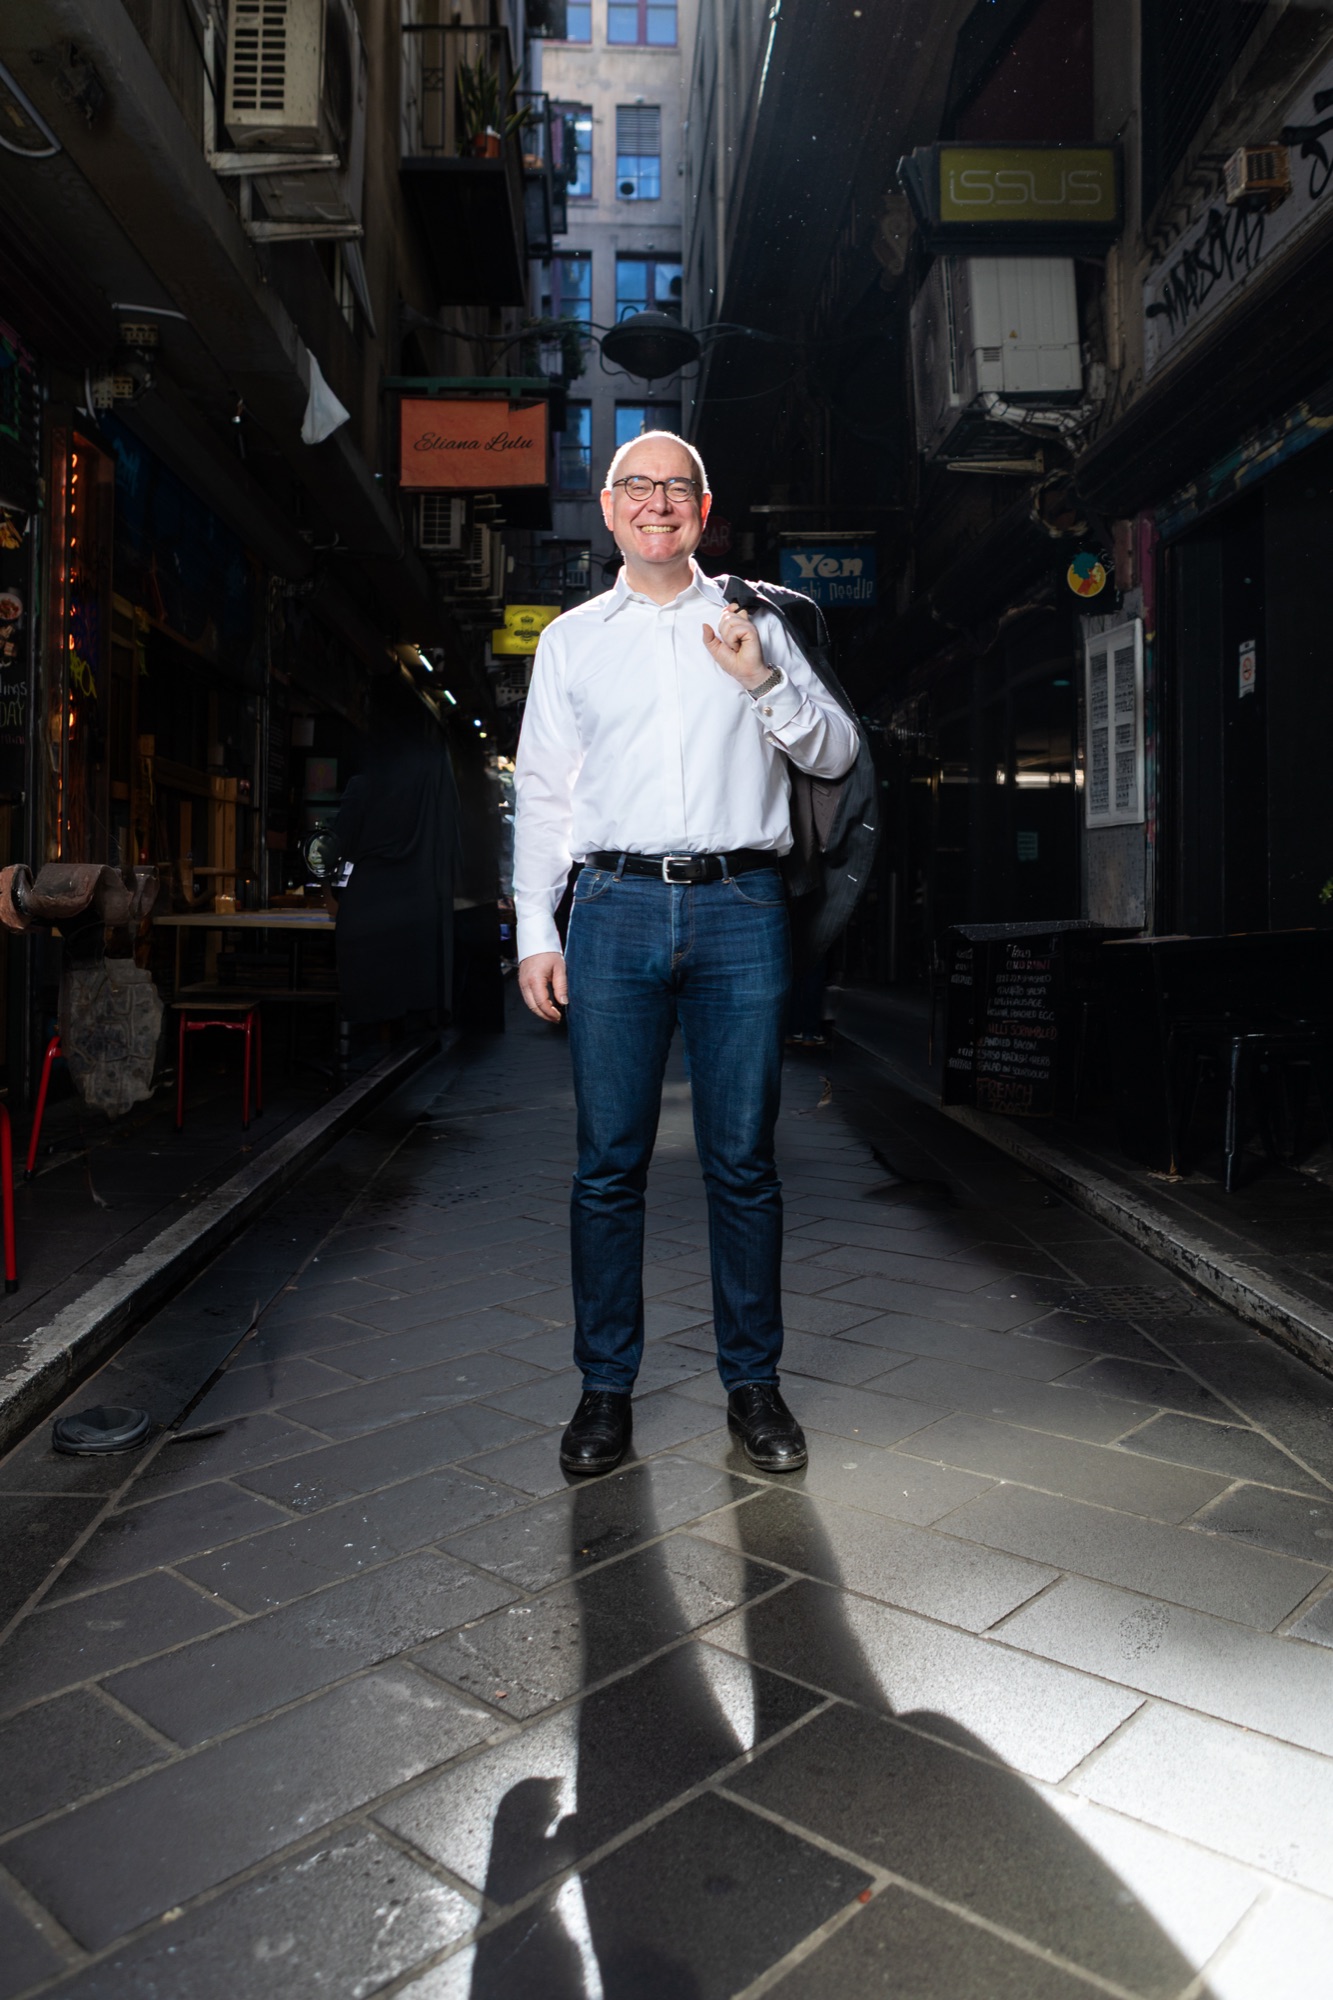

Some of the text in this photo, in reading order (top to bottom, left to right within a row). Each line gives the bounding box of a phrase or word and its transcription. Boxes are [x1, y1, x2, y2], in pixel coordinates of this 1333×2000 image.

[413, 431, 534, 452] Eliana Lulu
[790, 553, 864, 578] Yen
